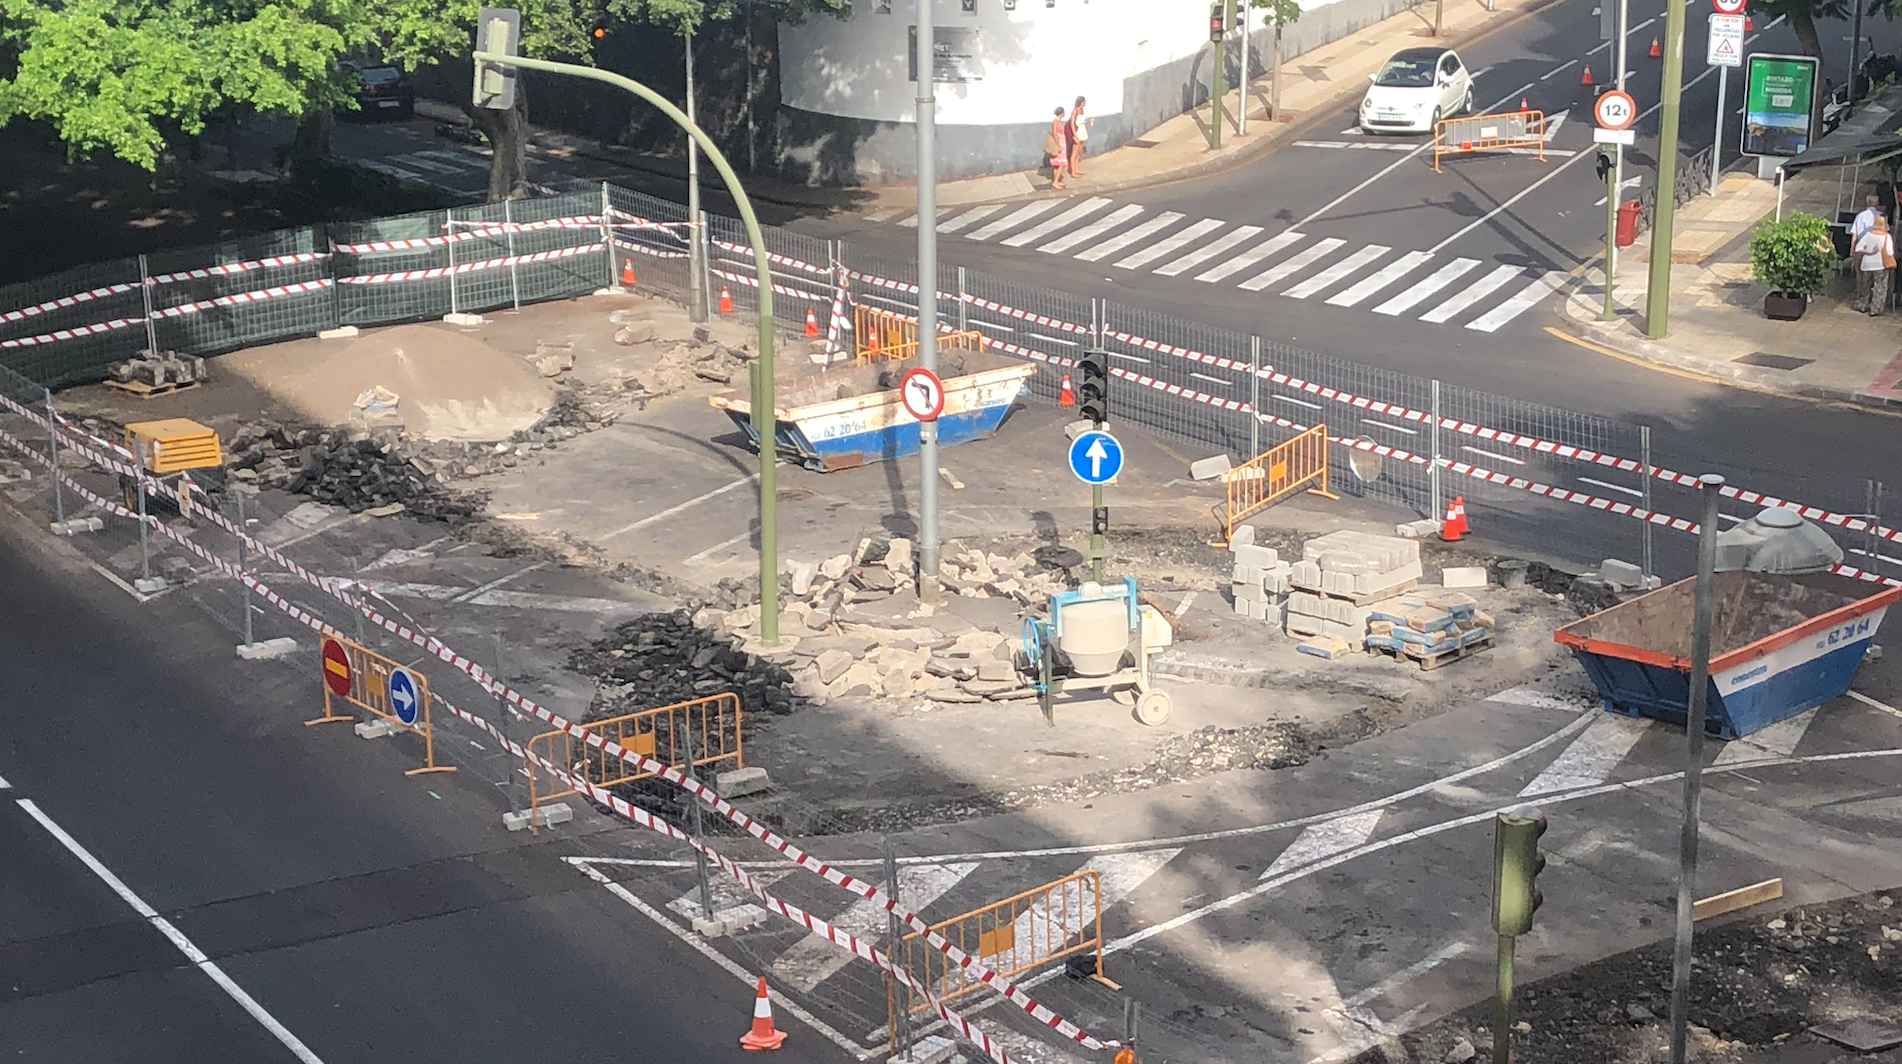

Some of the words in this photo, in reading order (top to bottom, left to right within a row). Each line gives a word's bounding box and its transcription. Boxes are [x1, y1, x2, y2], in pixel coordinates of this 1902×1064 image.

[824, 426, 835, 438] 62
[839, 423, 851, 435] 20
[1828, 629, 1840, 645] 62
